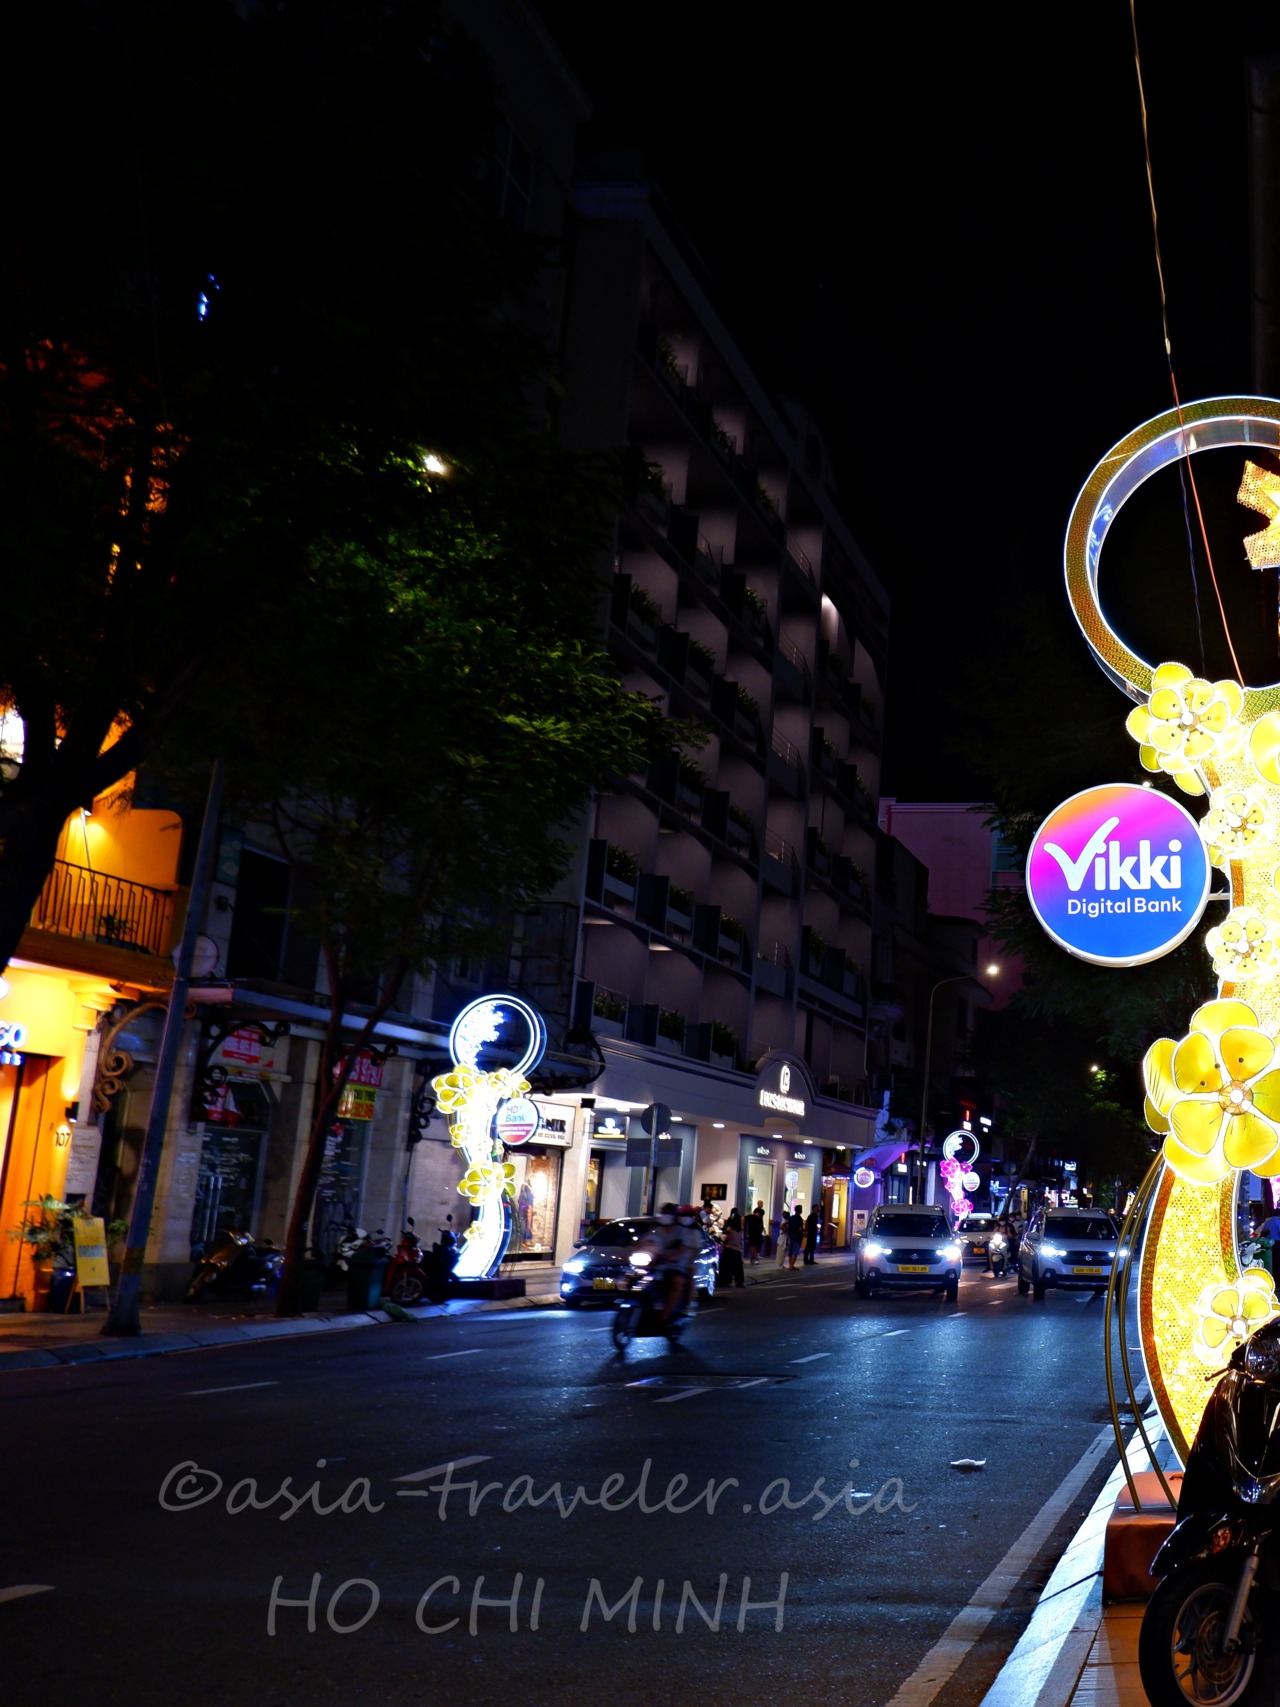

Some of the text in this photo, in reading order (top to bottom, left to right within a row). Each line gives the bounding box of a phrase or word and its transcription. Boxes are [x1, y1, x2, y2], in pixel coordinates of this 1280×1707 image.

[1043, 816, 1182, 892] Vikki
[1067, 896, 1182, 918] Digital Bank
[505, 1114, 526, 1123] Bank
[55, 1131, 71, 1147] 107
